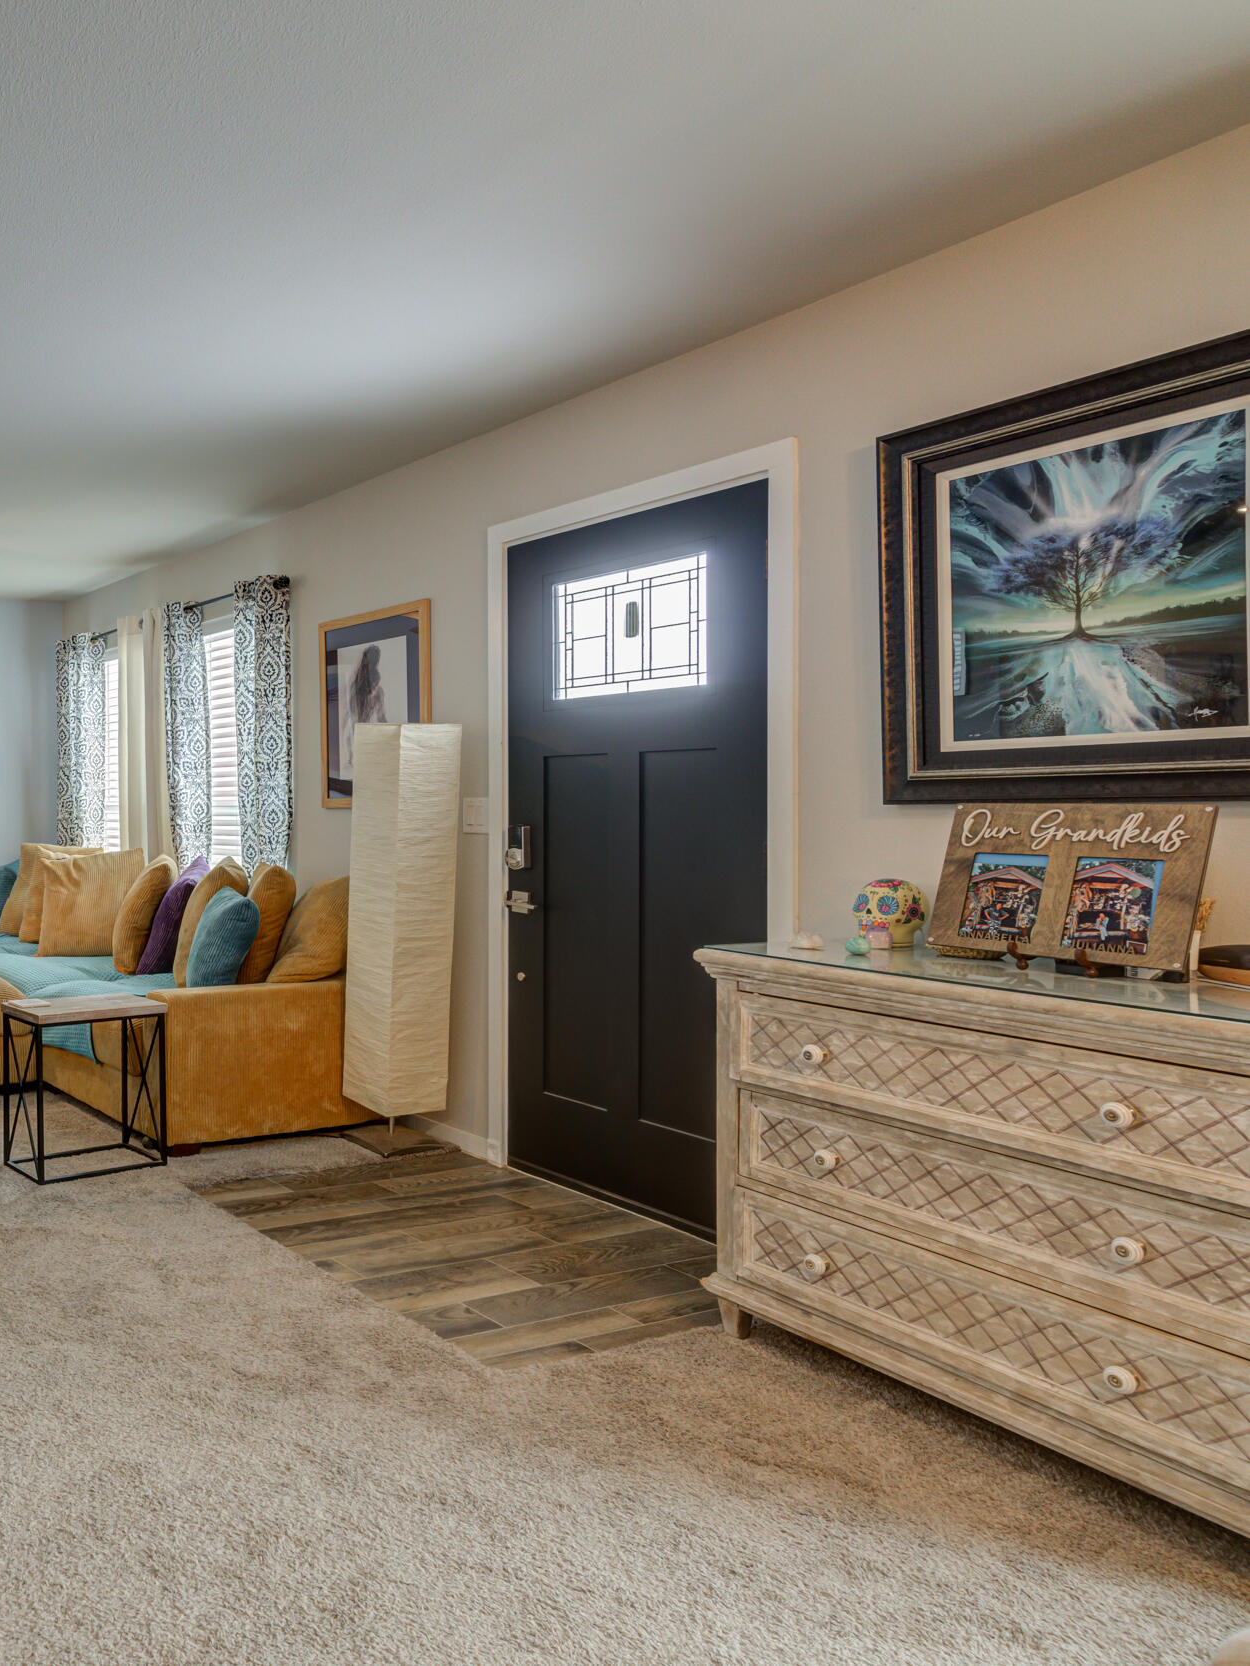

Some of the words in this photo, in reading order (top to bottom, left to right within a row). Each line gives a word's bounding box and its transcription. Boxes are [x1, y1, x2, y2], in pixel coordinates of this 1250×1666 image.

[961, 808, 1021, 847] Our
[1030, 808, 1191, 853] Grandkids
[959, 929, 1031, 944] ANNABELLA
[1070, 938, 1136, 955] JULIANNA
